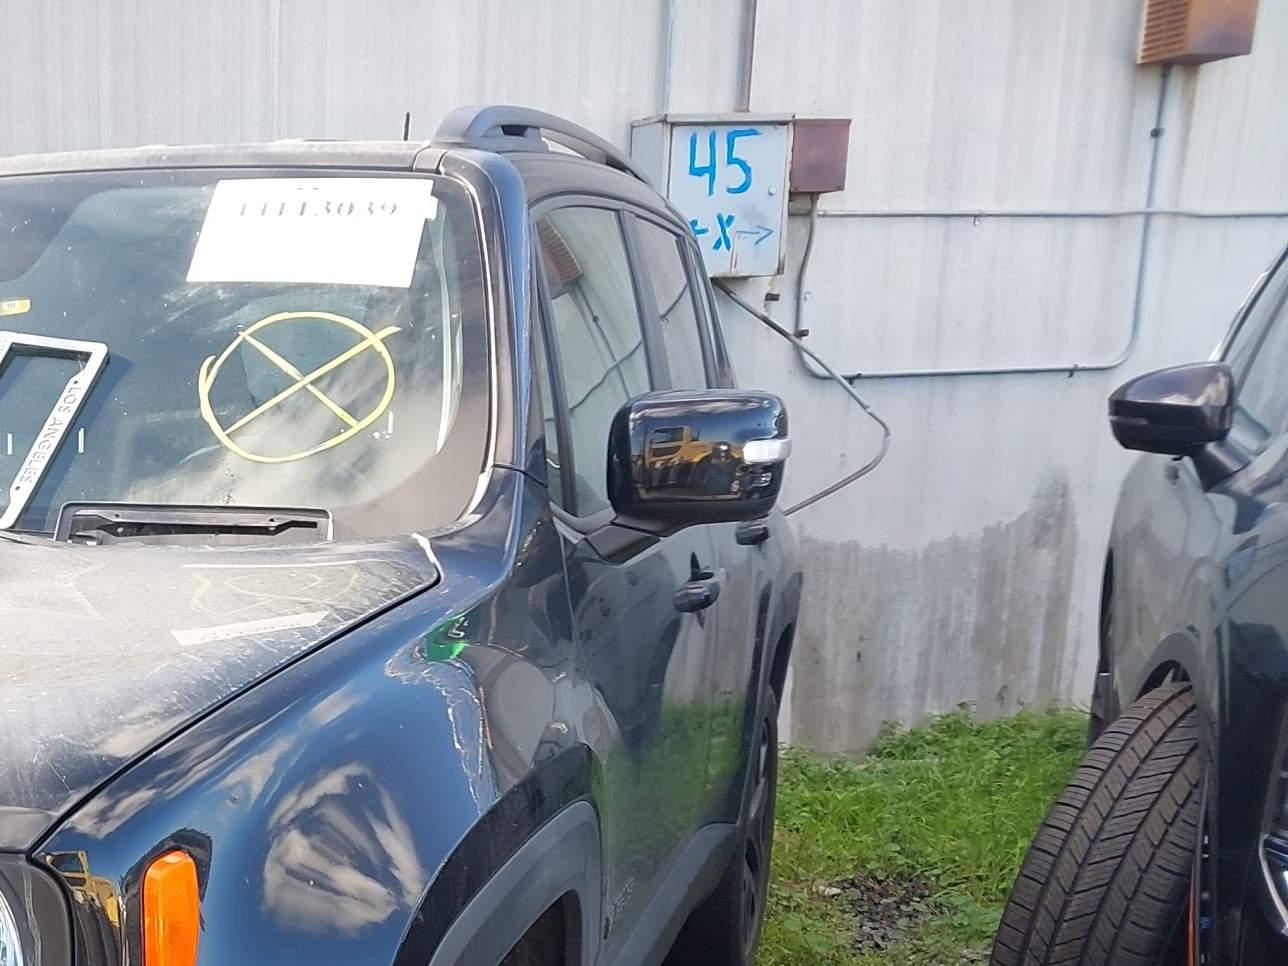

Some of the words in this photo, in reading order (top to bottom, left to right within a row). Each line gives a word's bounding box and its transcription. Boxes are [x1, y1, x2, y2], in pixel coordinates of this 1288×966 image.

[687, 128, 764, 197] 45
[57, 384, 83, 416] LOS
[18, 415, 65, 486] ANGELES
